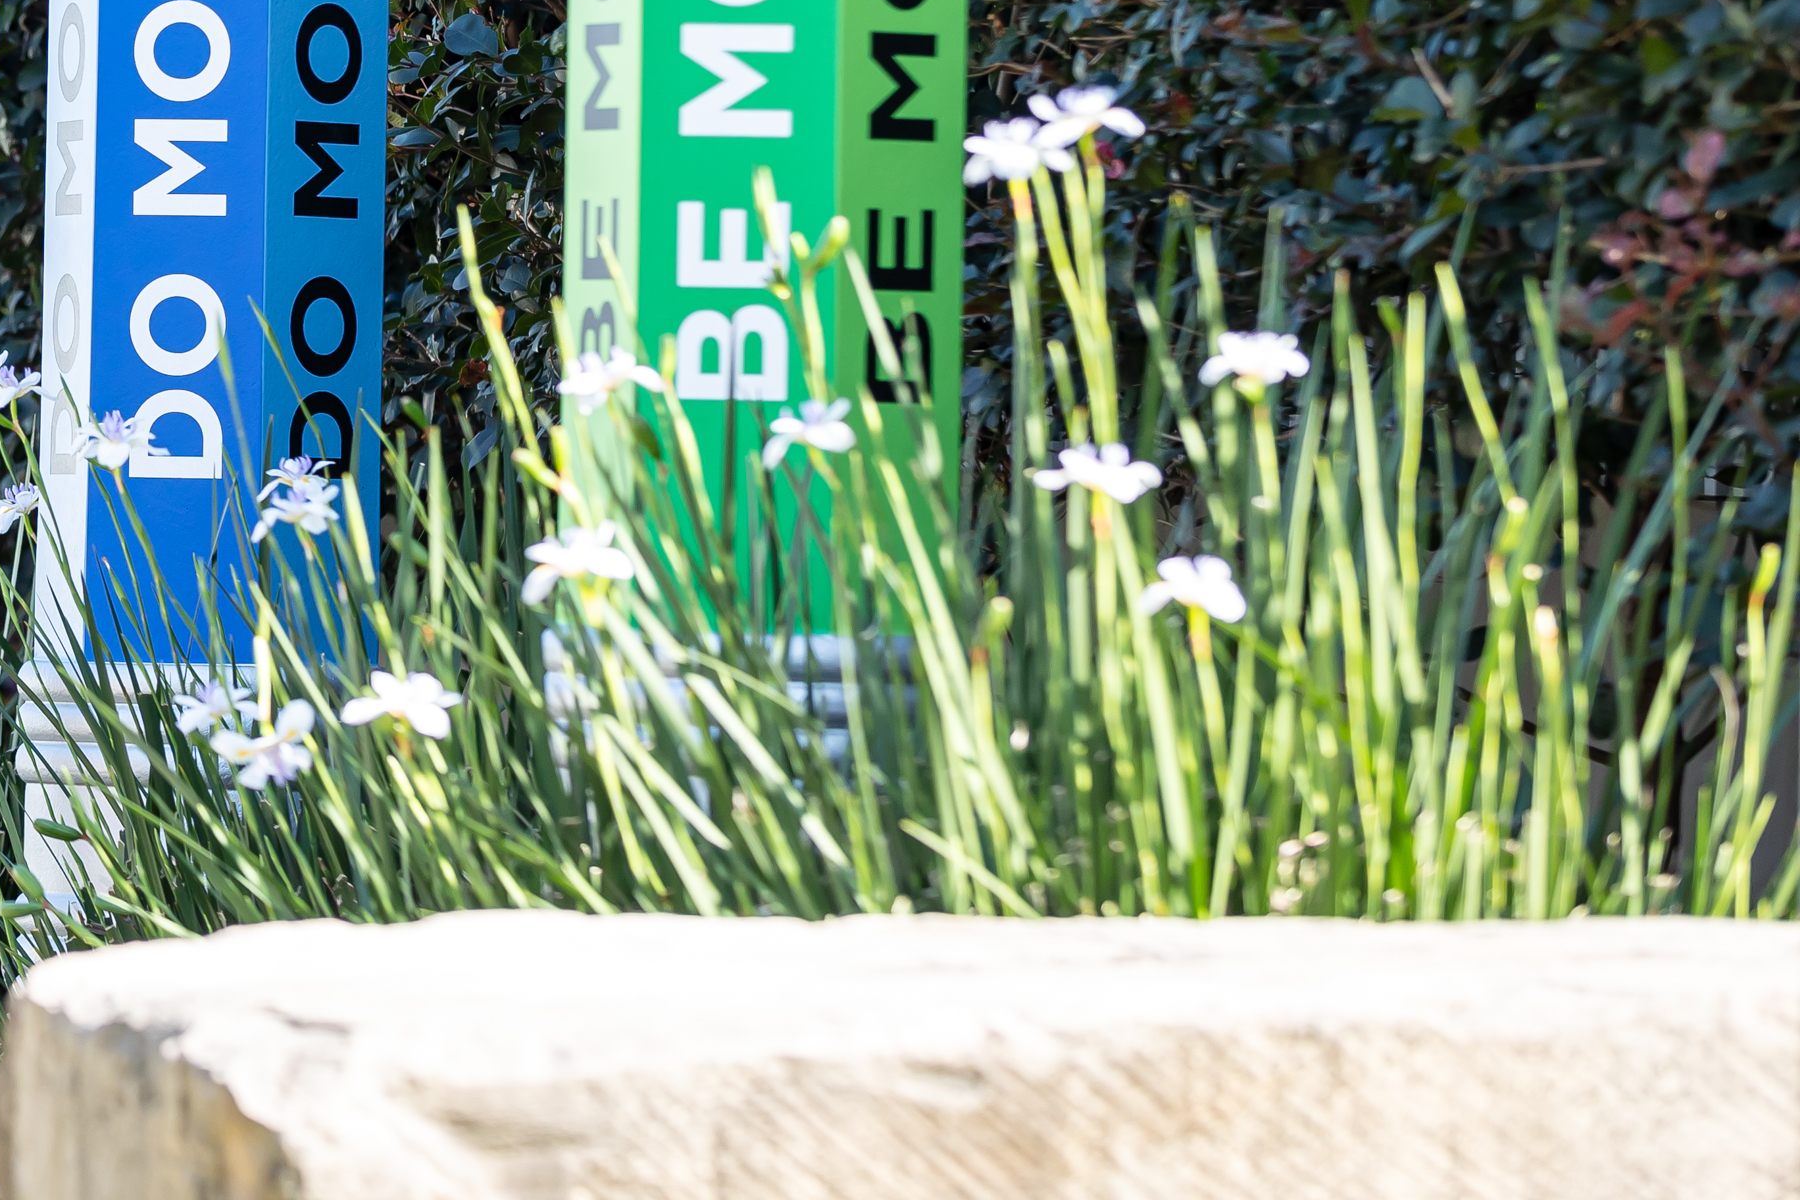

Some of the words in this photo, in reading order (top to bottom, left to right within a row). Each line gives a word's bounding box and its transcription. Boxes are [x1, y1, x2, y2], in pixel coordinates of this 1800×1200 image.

[50, 273, 80, 475] DO
[128, 273, 227, 480] DO
[289, 275, 358, 479] DO
[675, 200, 792, 401] BE
[866, 208, 935, 404] BE
